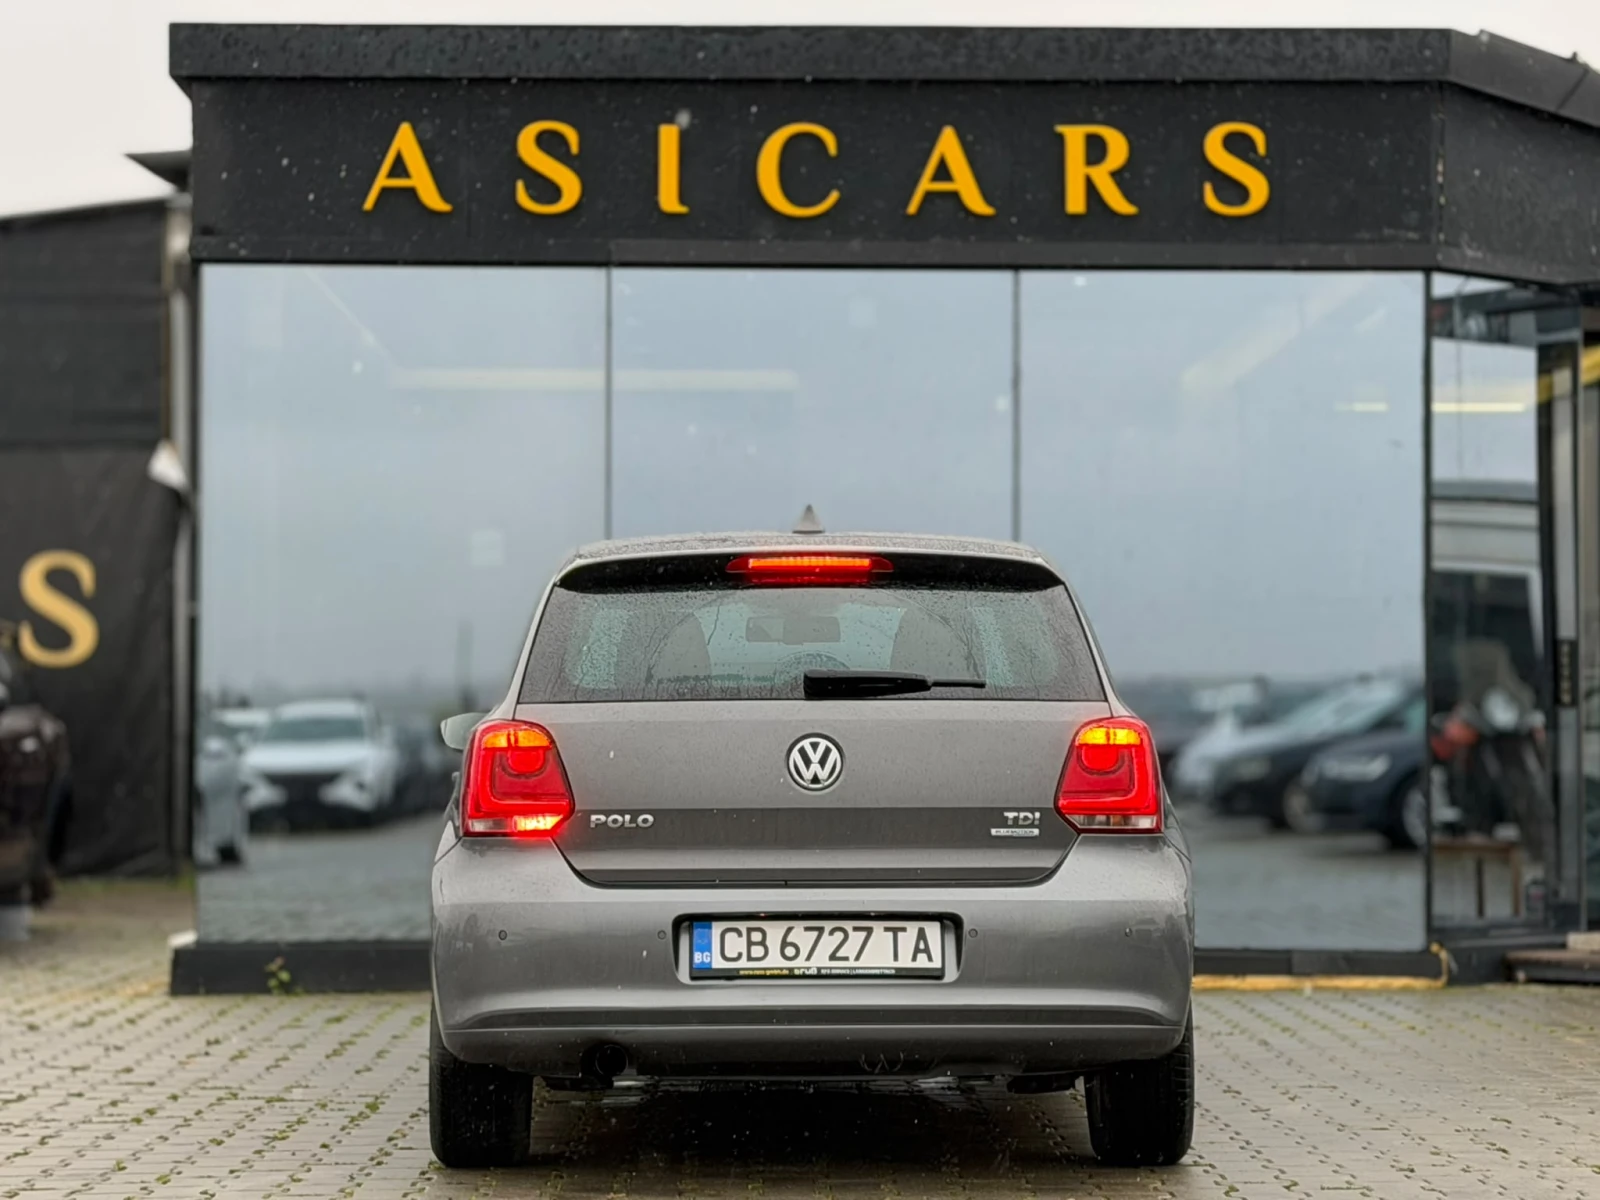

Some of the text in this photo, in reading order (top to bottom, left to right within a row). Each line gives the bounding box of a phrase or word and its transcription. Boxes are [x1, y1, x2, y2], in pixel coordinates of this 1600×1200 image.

[362, 120, 1271, 218] ASICARS
[589, 813, 655, 829] POLO
[1003, 811, 1041, 826] TDI
[719, 925, 934, 963] CB 6727 TA
[694, 951, 711, 964] BG
